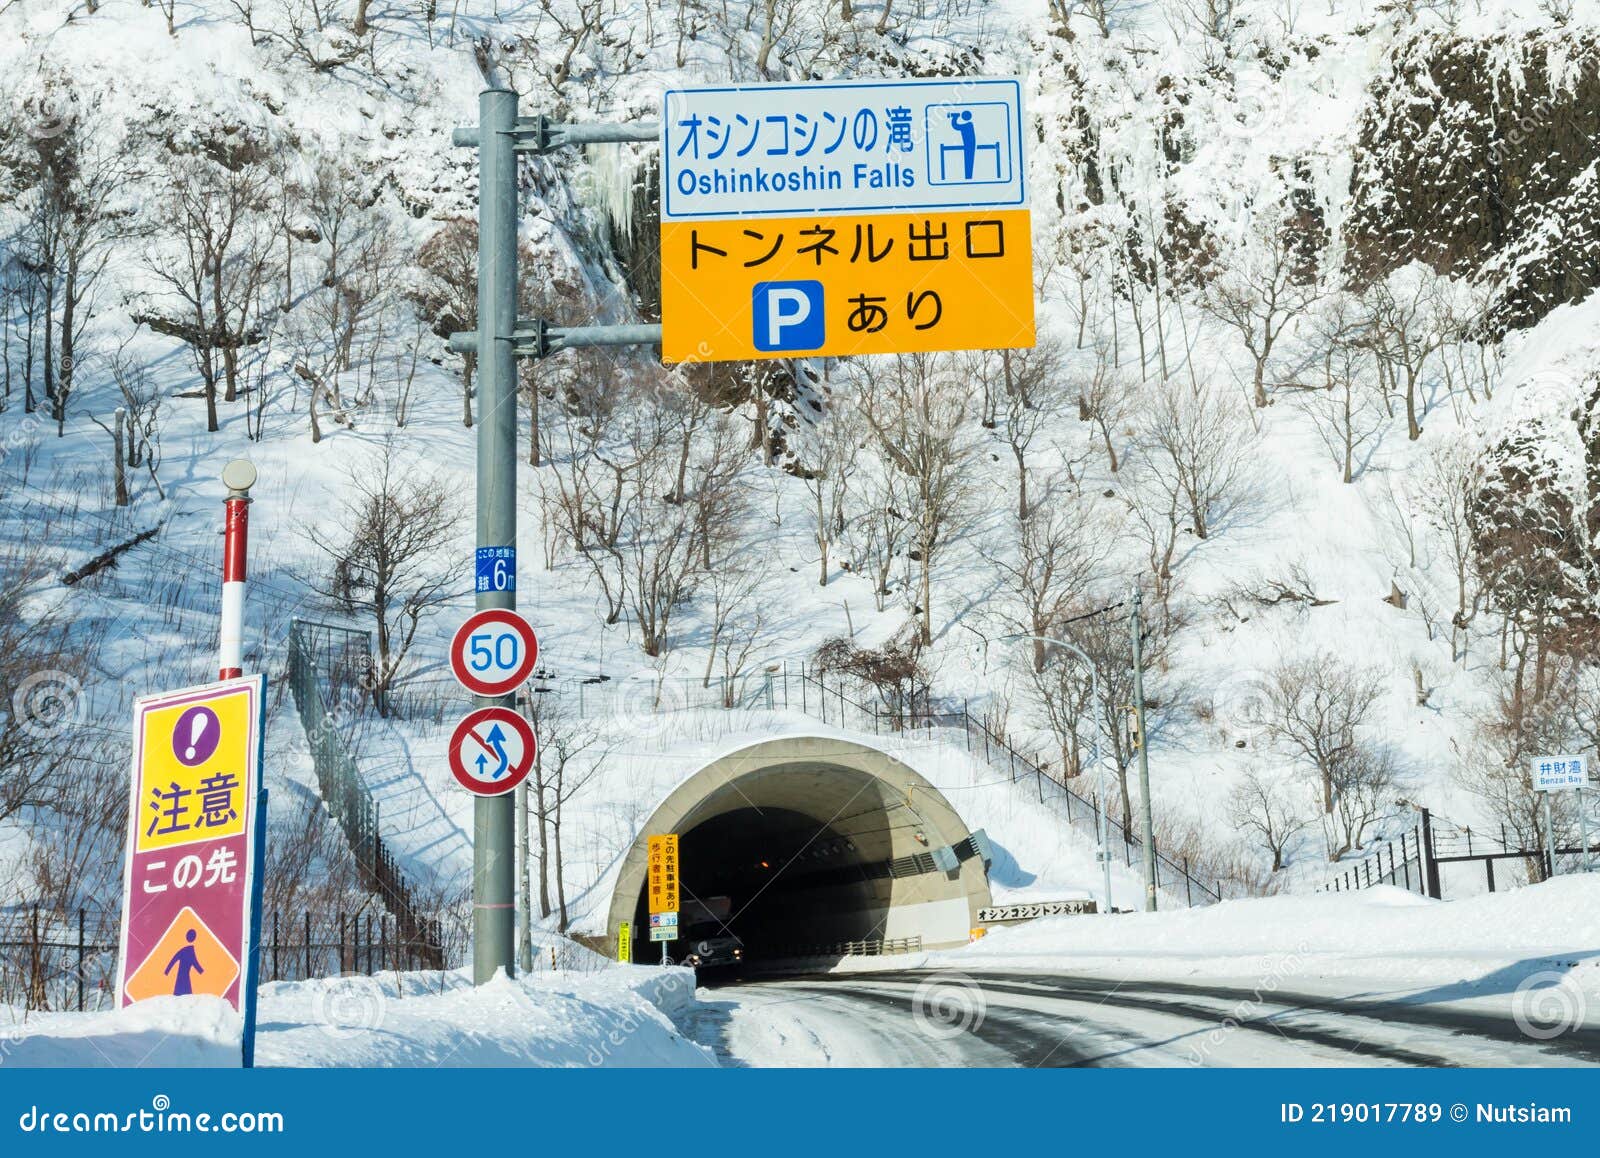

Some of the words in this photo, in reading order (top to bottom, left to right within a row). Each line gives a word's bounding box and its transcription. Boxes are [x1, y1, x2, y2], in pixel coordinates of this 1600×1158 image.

[677, 105, 914, 160] オシンコシンの滝
[677, 164, 842, 196] Oshinkoshin
[853, 162, 915, 190] Falls
[690, 219, 1005, 270] トンネル出口
[767, 287, 811, 346] P
[847, 289, 943, 333] あり
[471, 633, 518, 672] 50
[1540, 760, 1581, 775] 弁財湾
[1540, 777, 1565, 785] Benzai
[146, 772, 240, 837] 注意
[143, 846, 238, 894] この先
[978, 903, 1082, 920] オシンコシントンネル
